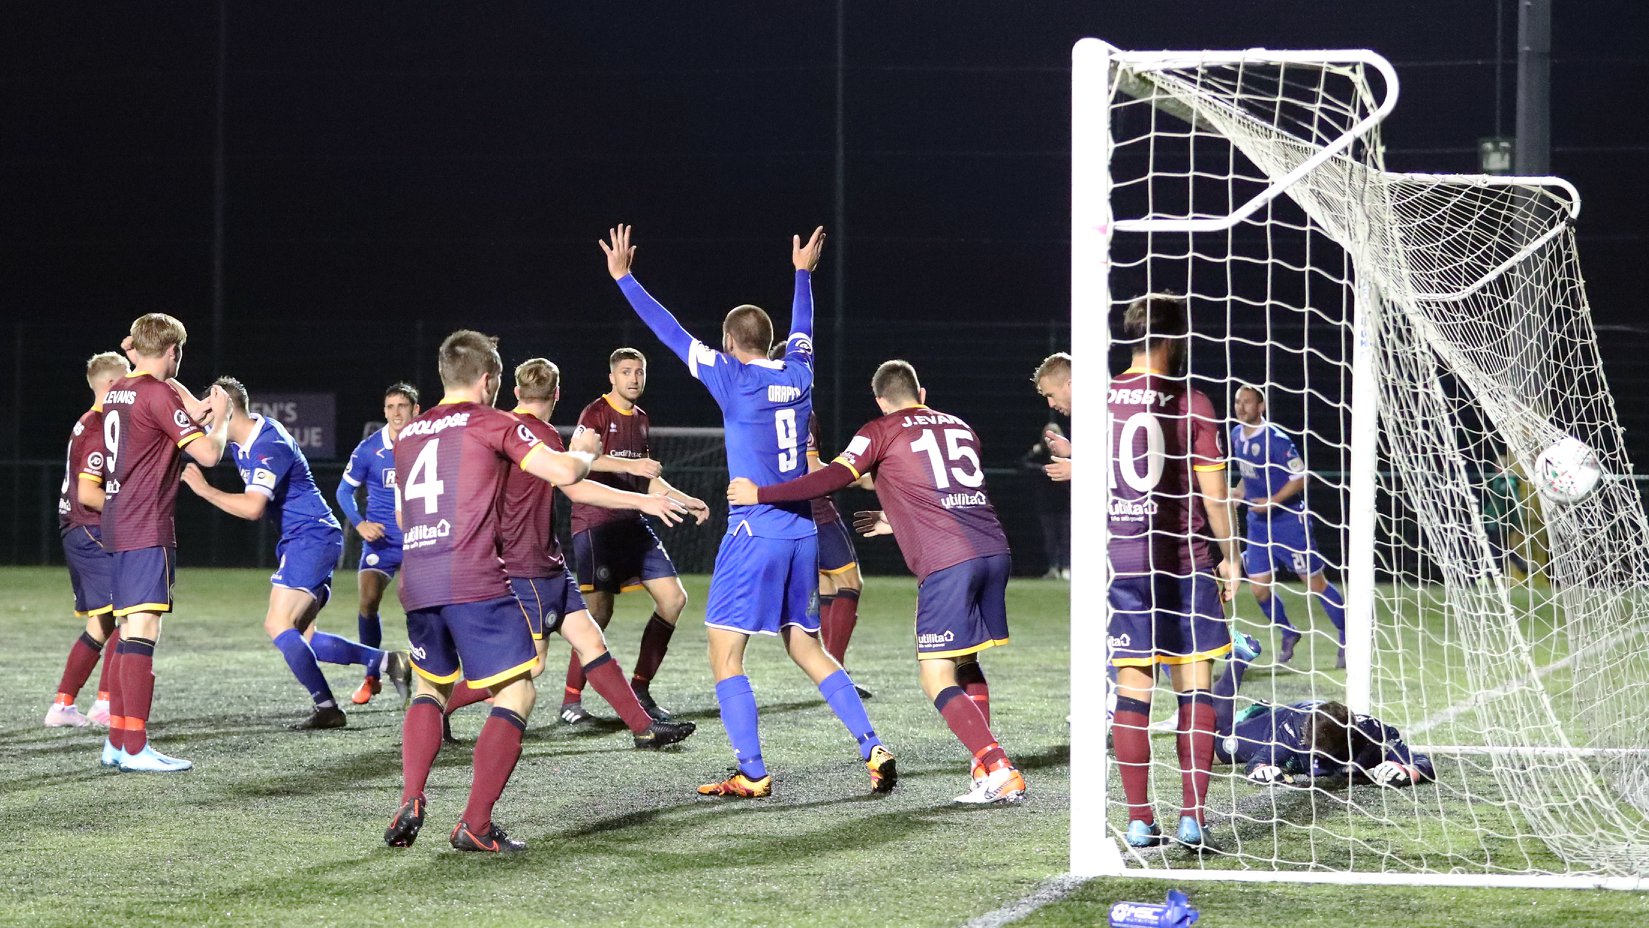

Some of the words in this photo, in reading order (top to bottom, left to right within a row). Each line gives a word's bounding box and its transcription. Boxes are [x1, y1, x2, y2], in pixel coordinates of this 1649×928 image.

[250, 402, 298, 423] EN'S
[1107, 389, 1174, 407] ORSBY
[104, 409, 121, 474] 9
[775, 408, 797, 473] 9
[910, 428, 984, 489] 15
[1106, 411, 1165, 493] 10
[404, 438, 444, 515] 4
[941, 493, 978, 509] utilita
[918, 634, 945, 643] utilita
